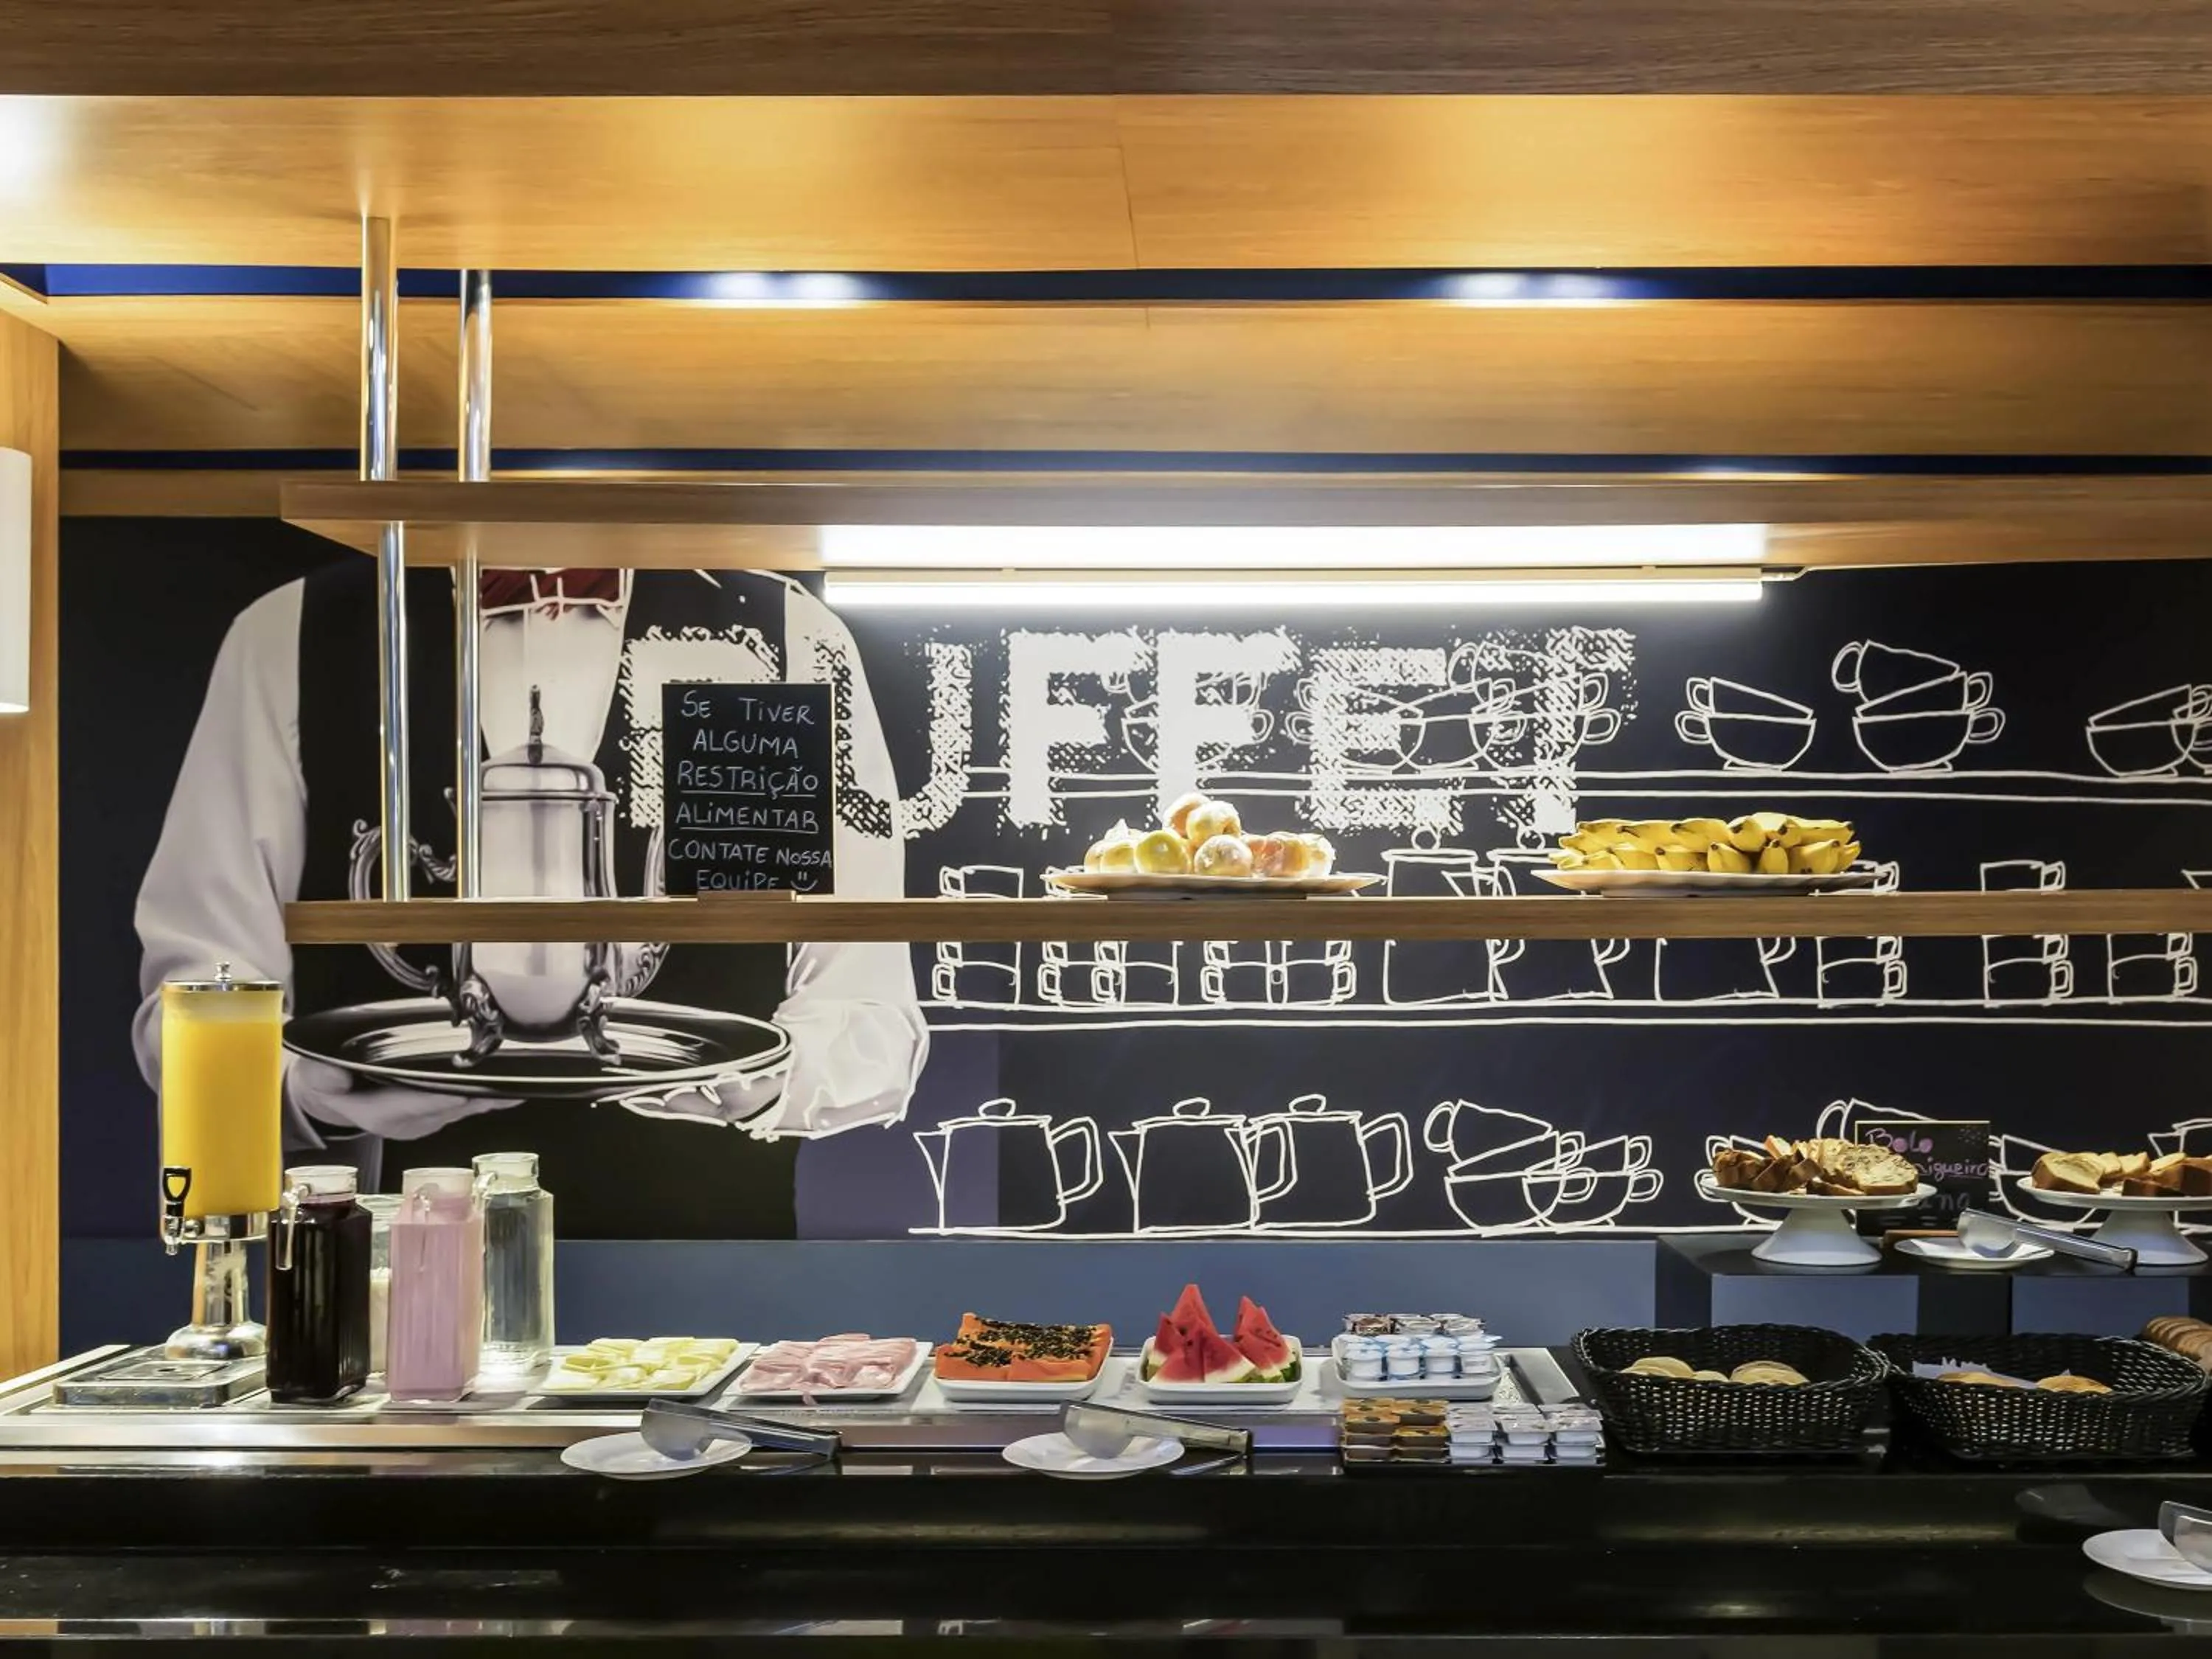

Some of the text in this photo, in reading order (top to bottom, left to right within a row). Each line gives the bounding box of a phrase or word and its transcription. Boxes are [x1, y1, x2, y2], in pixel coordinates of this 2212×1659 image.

[681, 689, 712, 718] SE
[692, 728, 799, 759] ALGUMA
[667, 838, 832, 868] CONTATE NOSSA
